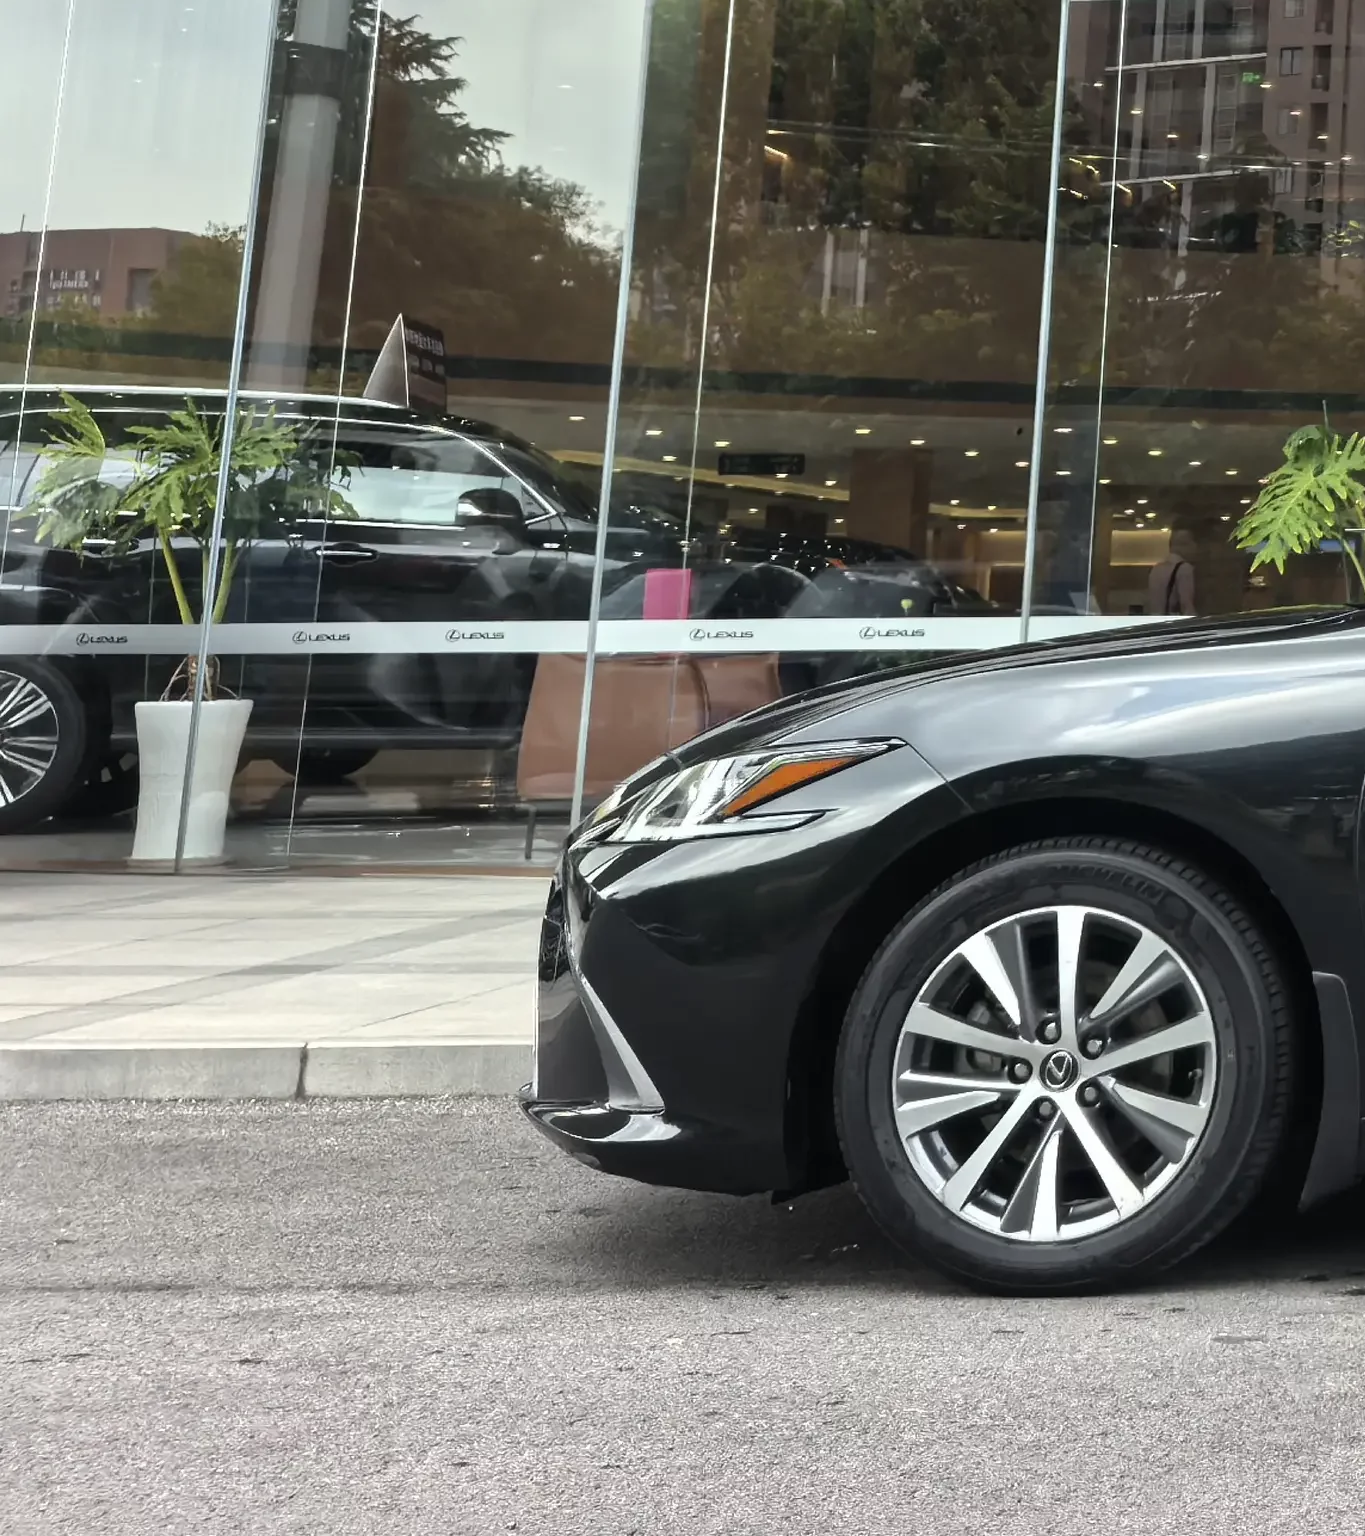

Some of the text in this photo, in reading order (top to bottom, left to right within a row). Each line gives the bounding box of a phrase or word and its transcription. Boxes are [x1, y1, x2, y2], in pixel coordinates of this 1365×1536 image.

[462, 632, 505, 640] LEXUS
[707, 630, 754, 639] LEXUS
[877, 628, 926, 637] LEXUS
[90, 635, 128, 644] LEXUS
[308, 633, 351, 642] LEXUS
